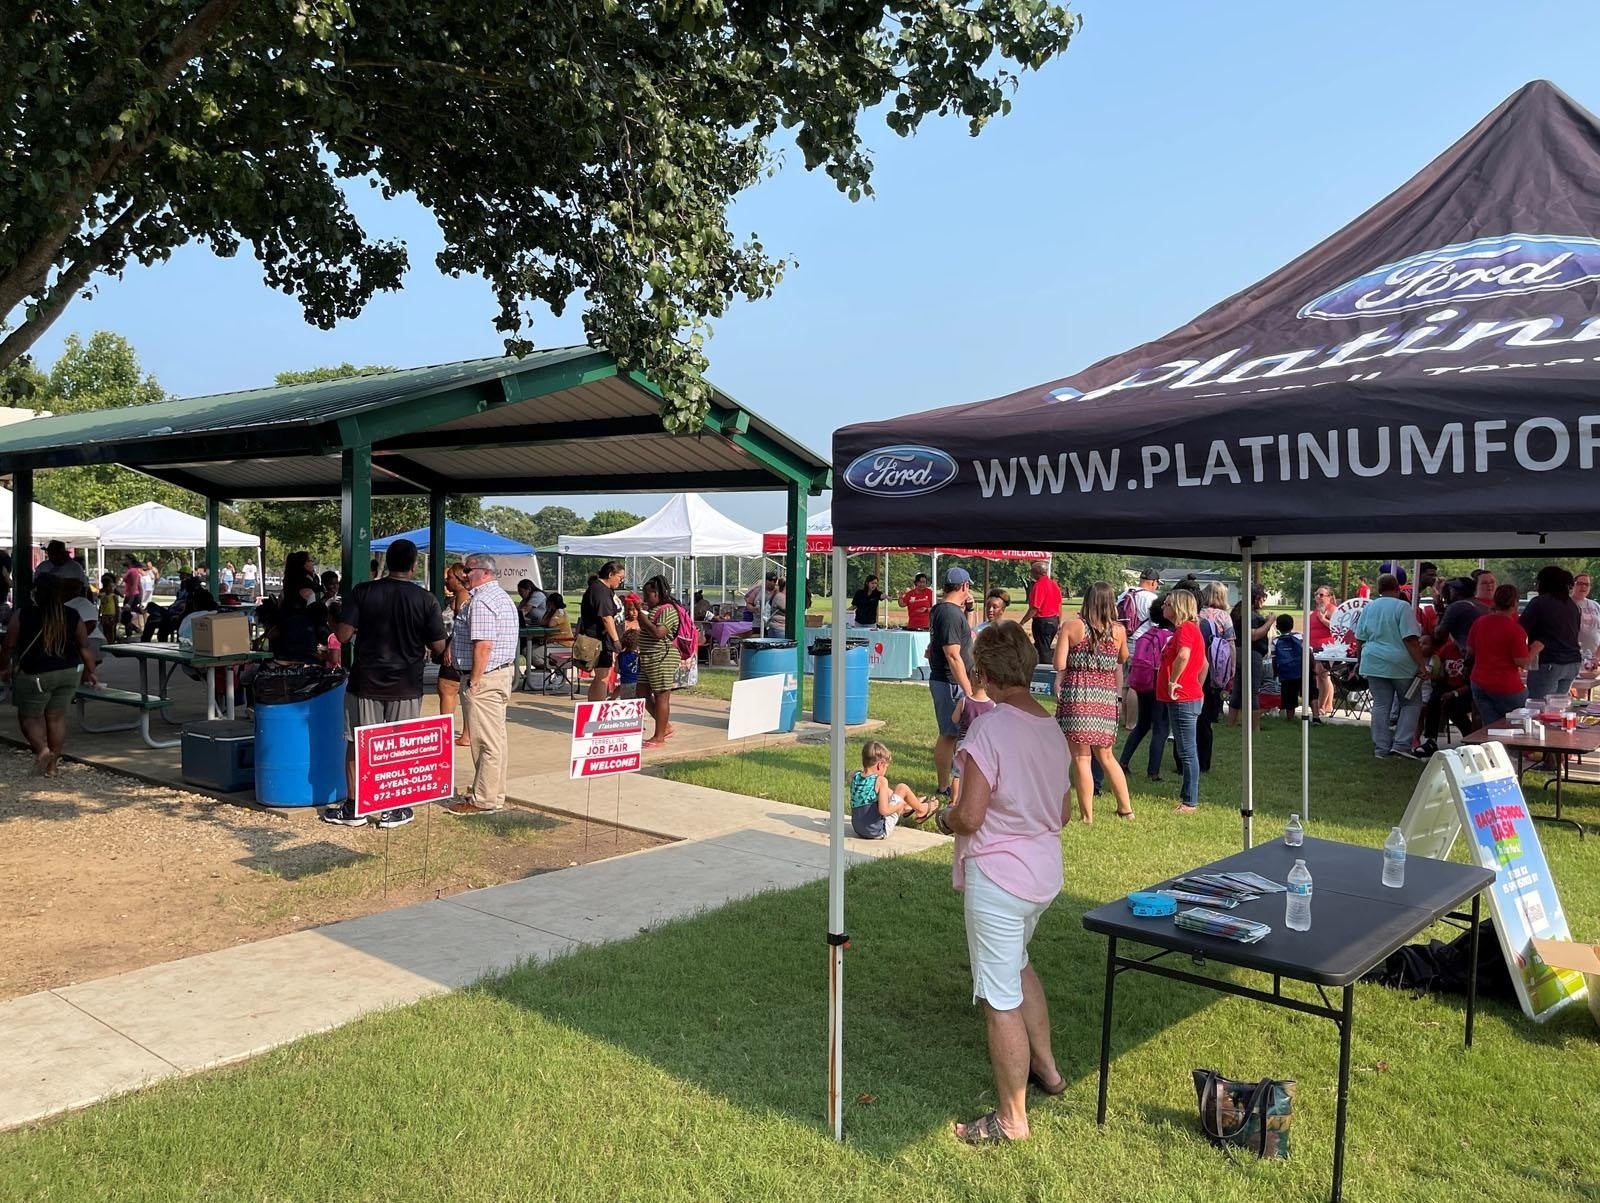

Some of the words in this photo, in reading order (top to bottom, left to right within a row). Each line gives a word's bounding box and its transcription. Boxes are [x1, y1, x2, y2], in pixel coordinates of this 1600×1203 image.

[1355, 245, 1575, 309] Ford
[1050, 308, 1600, 401] Platin
[864, 454, 934, 488] Ford
[373, 739, 398, 752] W.H.
[399, 731, 439, 748] Burnett
[587, 745, 606, 756] JOB
[608, 743, 628, 754] FAIR
[373, 752, 389, 761] Early
[389, 747, 419, 758] Childhood
[419, 744, 439, 754] Center
[374, 769, 407, 781] ENROLL
[408, 763, 438, 775] TODAY!
[590, 757, 637, 771] WELCOME!
[379, 773, 433, 790] 4-YEAR-OLDS
[373, 782, 438, 802] 972-563-1452
